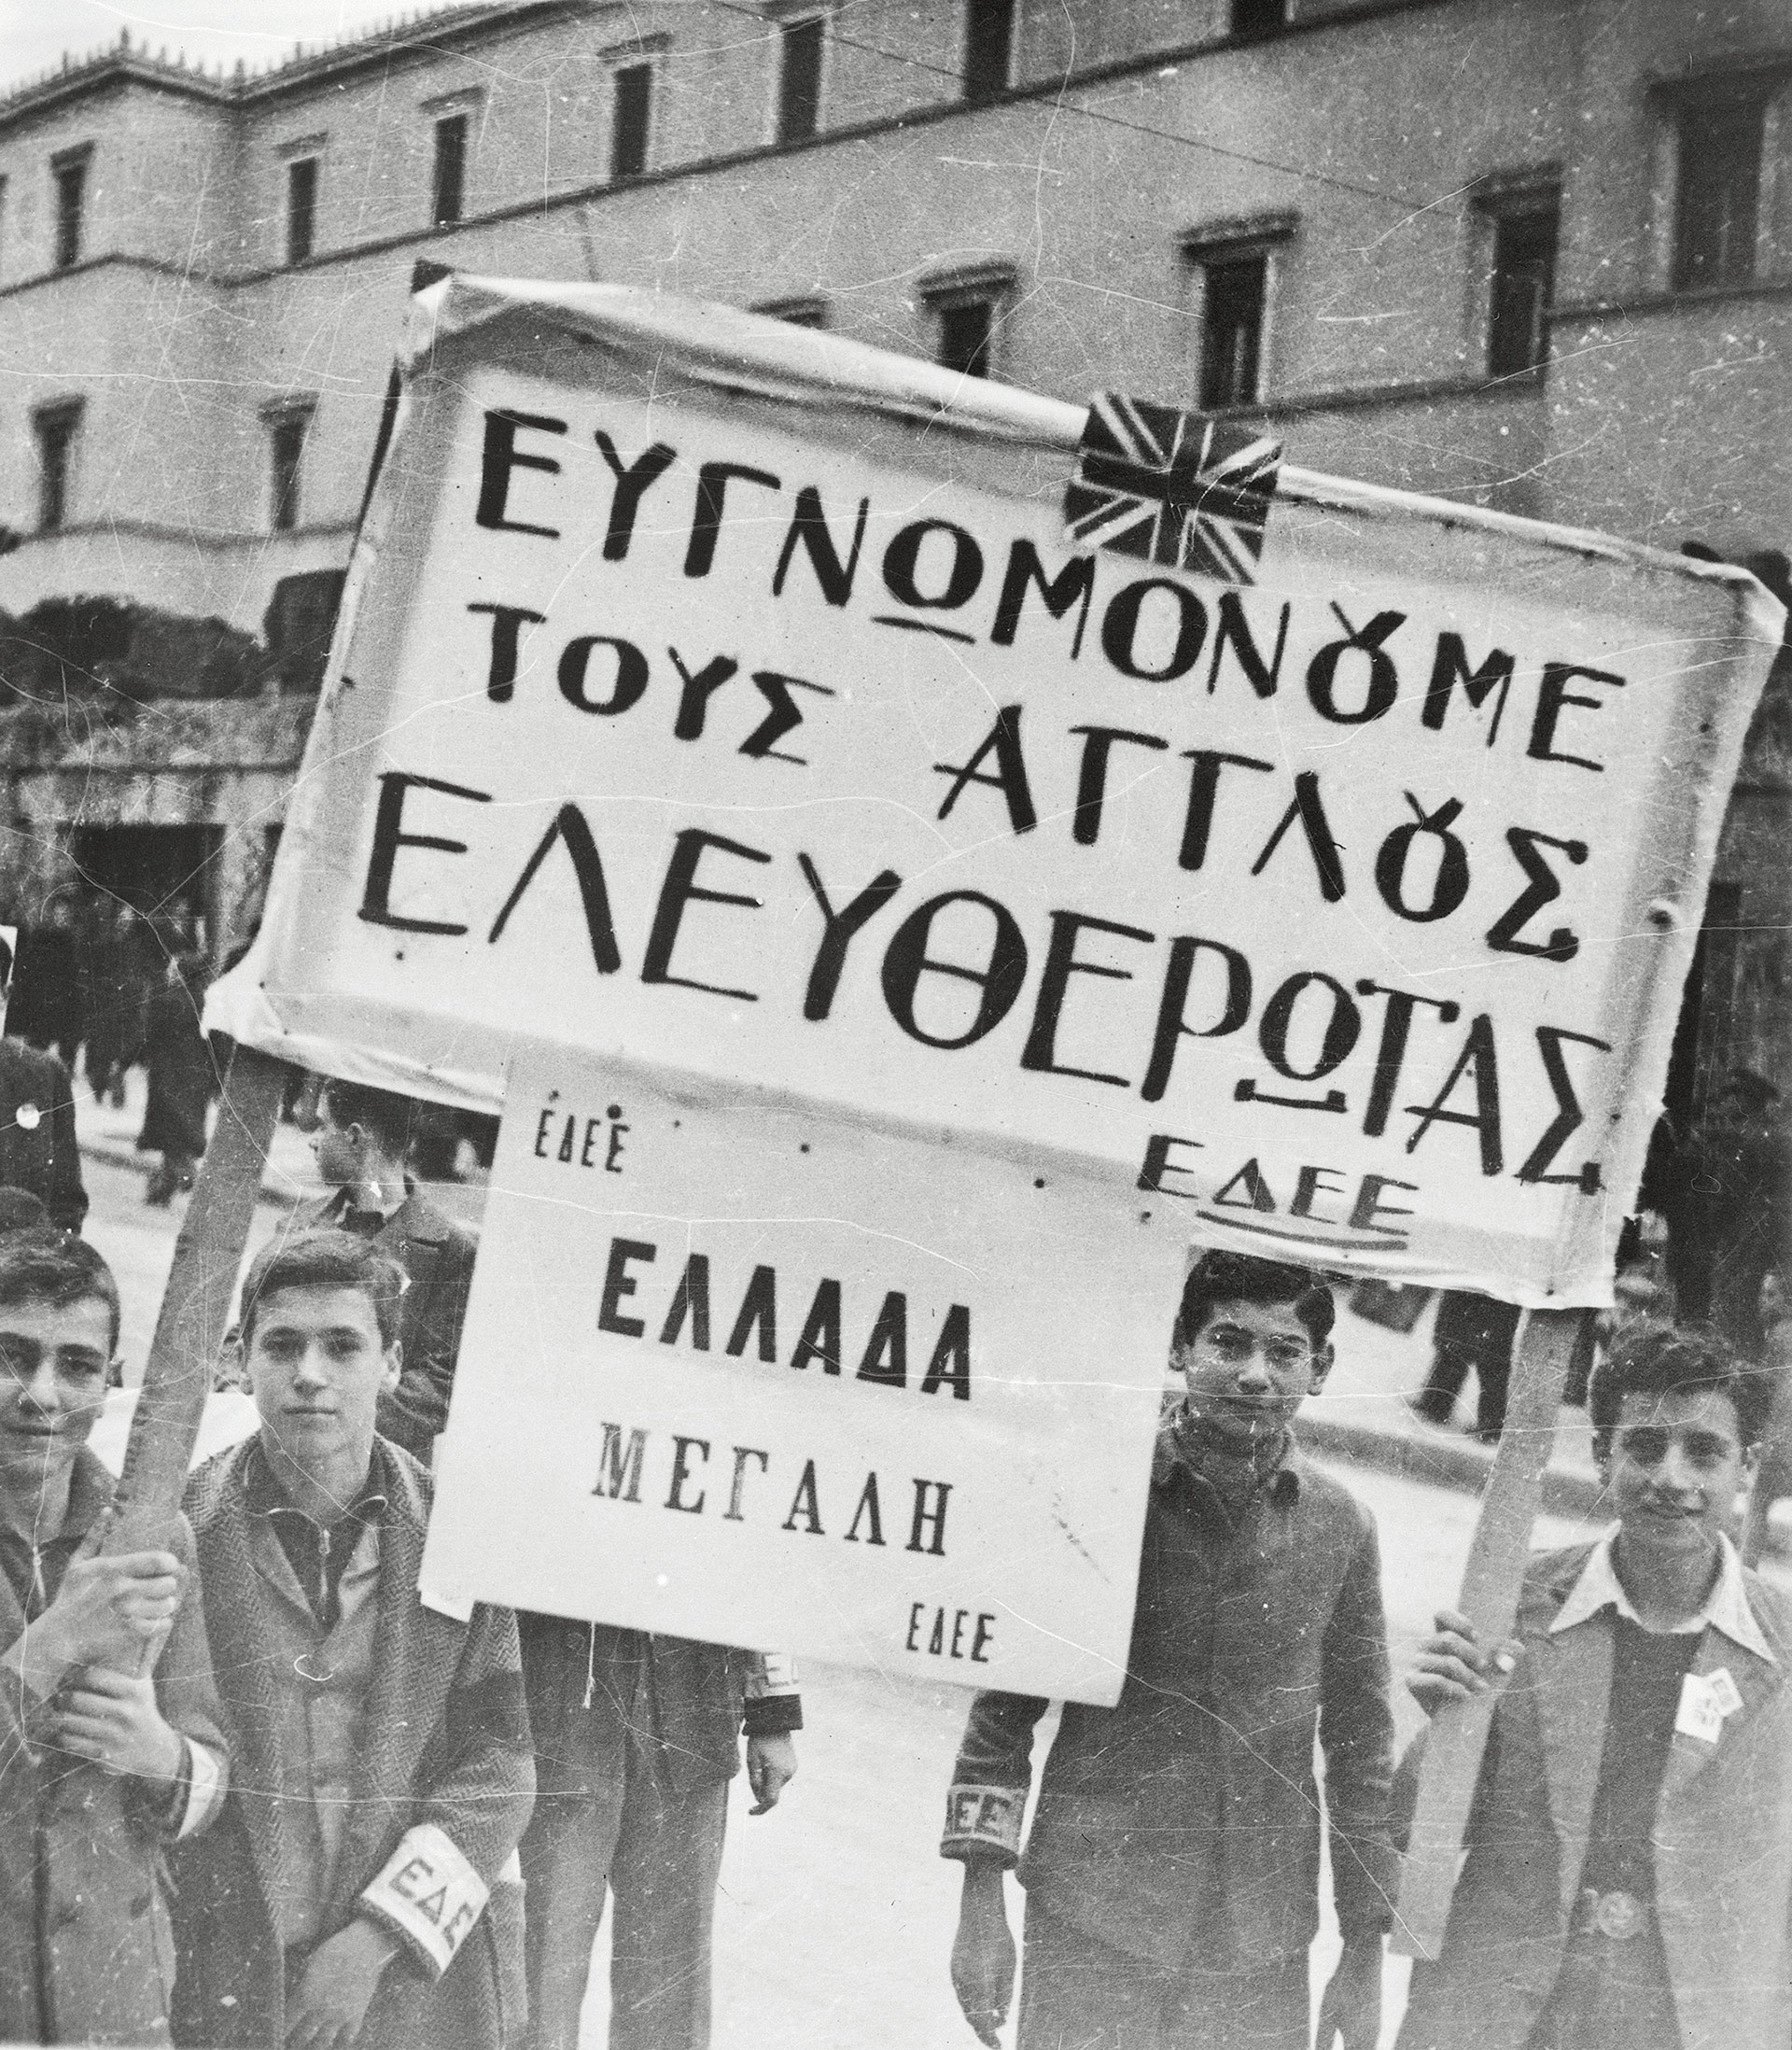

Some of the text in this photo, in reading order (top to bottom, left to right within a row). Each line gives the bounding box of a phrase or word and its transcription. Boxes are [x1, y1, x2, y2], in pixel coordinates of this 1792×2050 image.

[467, 602, 836, 765] ΤΟΥΣ
[357, 770, 1613, 1195] ΕΛΕΥΘΕΡΩΤΑΣ
[1136, 1133, 1421, 1236] ΕΔΕΕ
[597, 1237, 972, 1400] ΕΛΛΑΔΑ
[591, 1422, 954, 1556] ΜΕΓΑΛΗ
